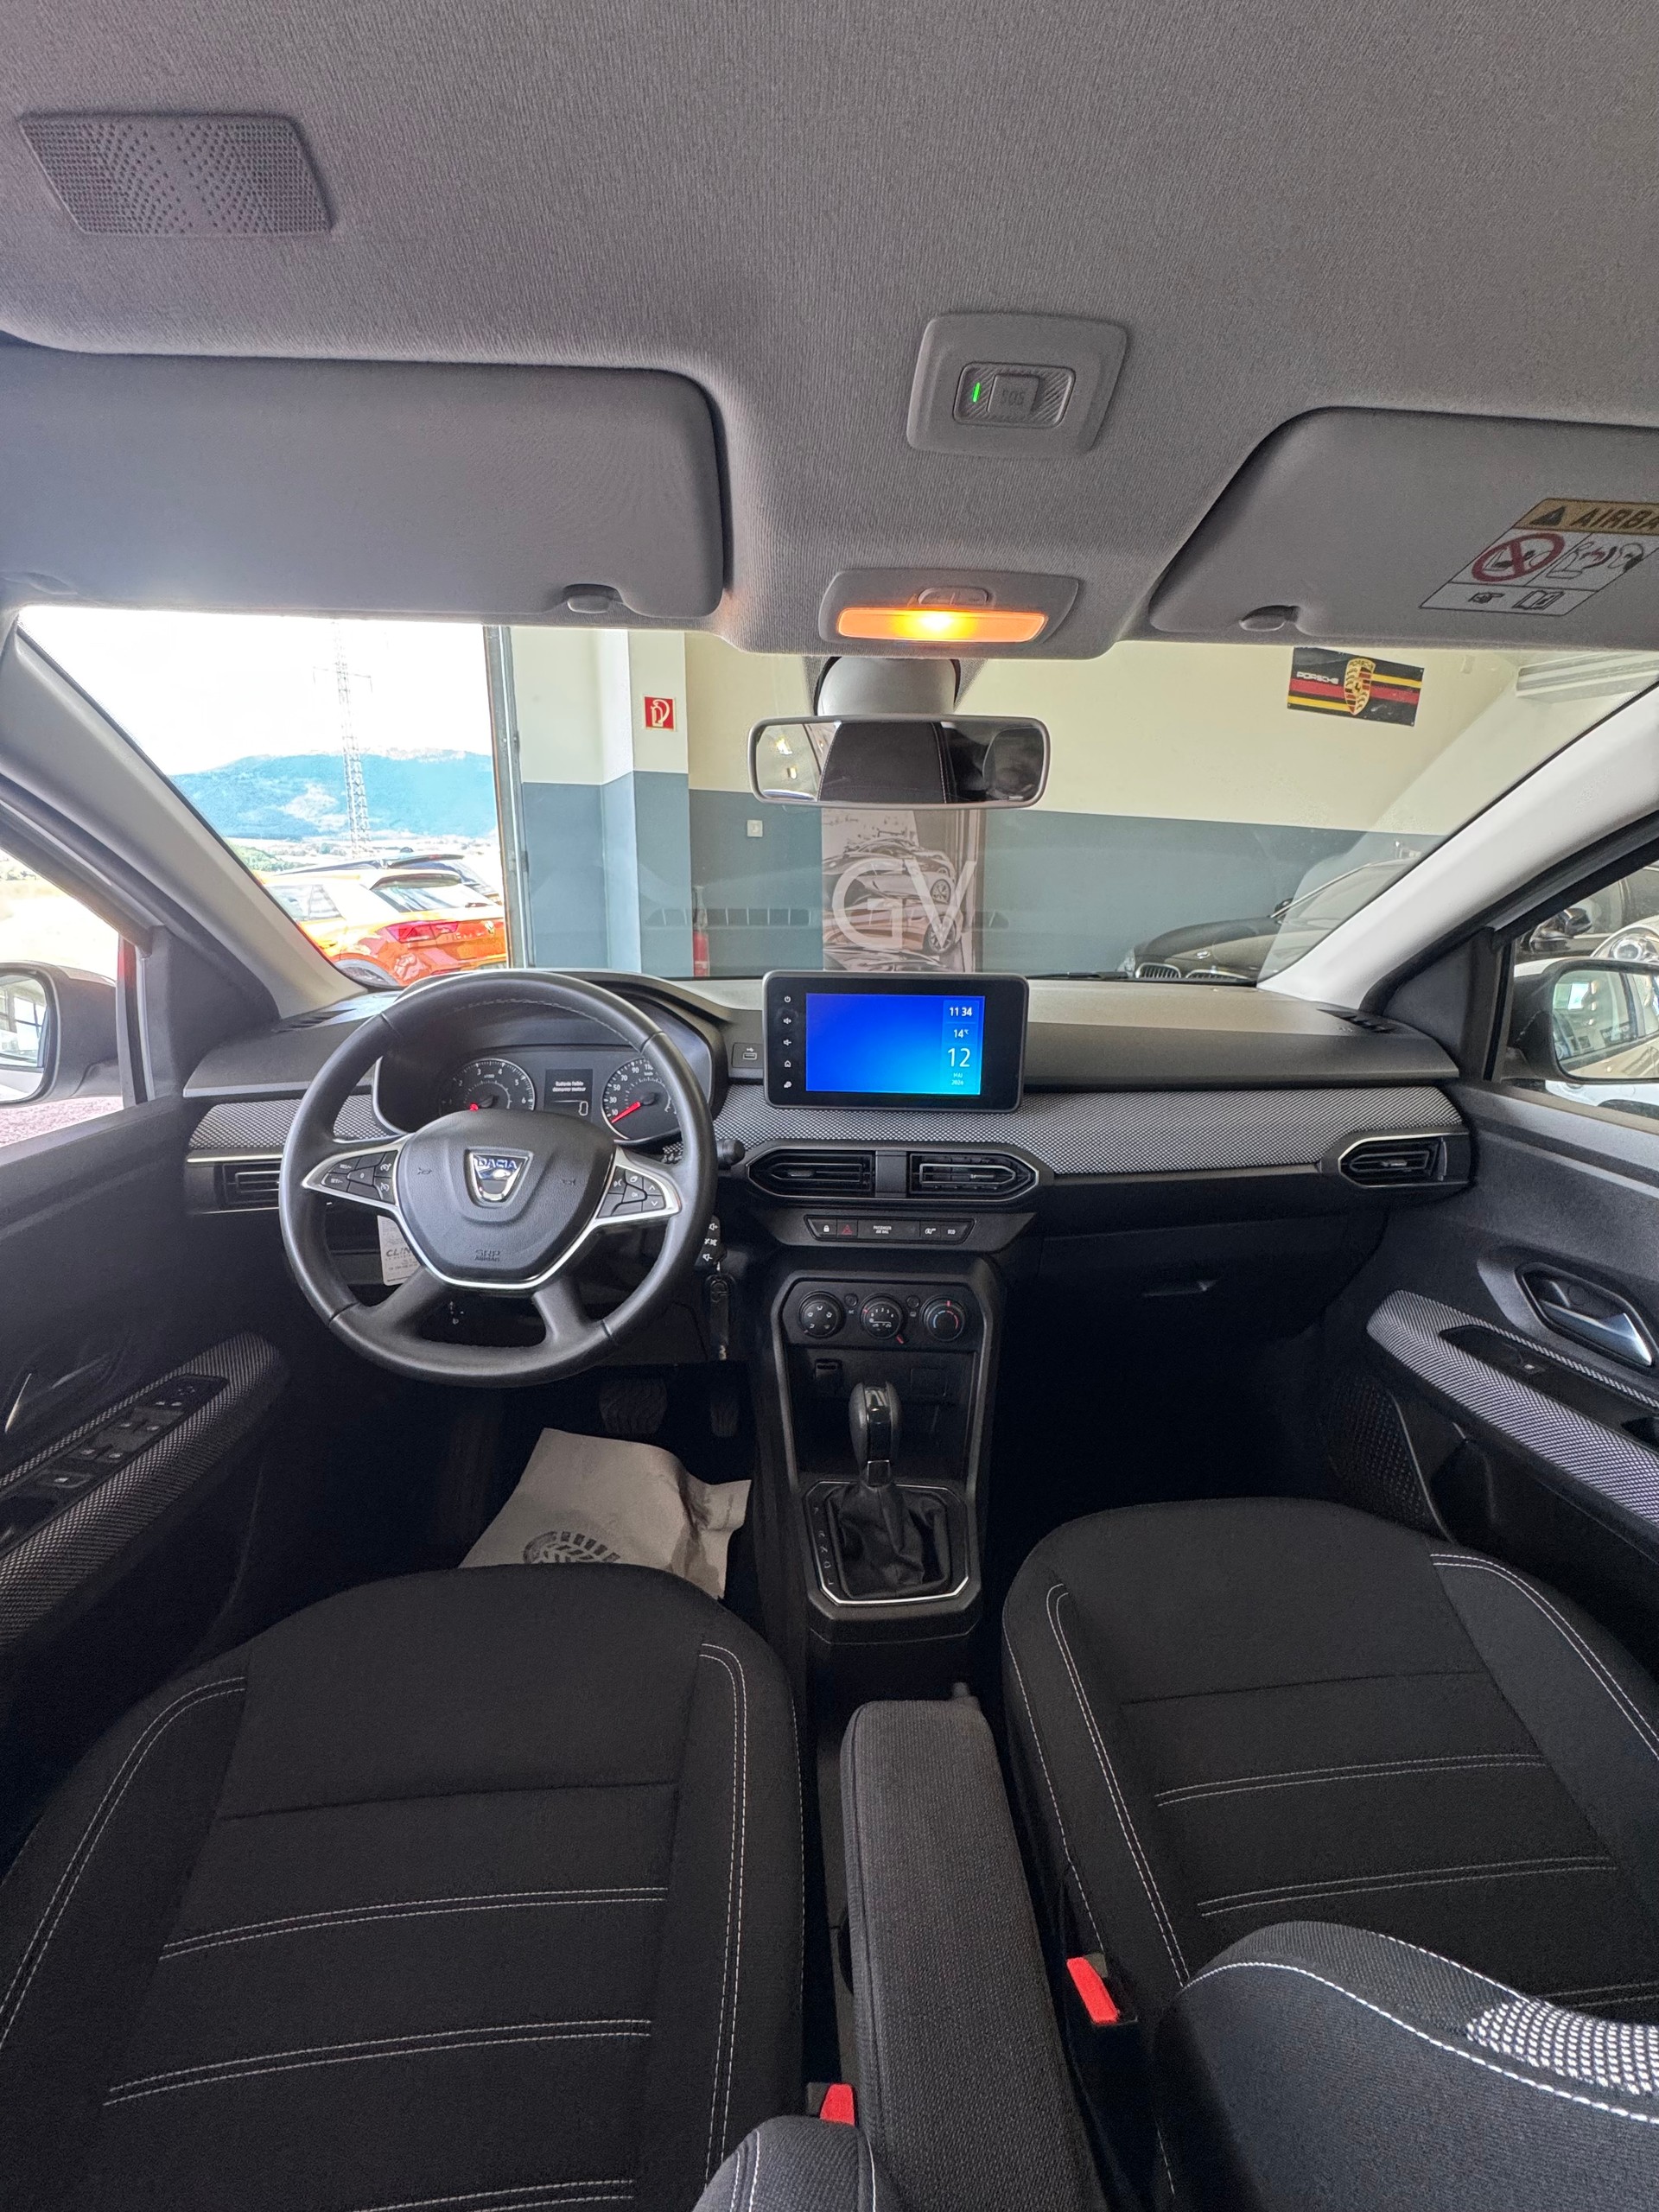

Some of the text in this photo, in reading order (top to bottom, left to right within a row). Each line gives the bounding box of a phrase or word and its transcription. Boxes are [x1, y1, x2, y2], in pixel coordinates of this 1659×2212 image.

[1001, 389, 1026, 406] SOS
[1296, 671, 1338, 685] PORSCHE
[947, 1047, 971, 1068] 12
[476, 1157, 518, 1169] DACIA
